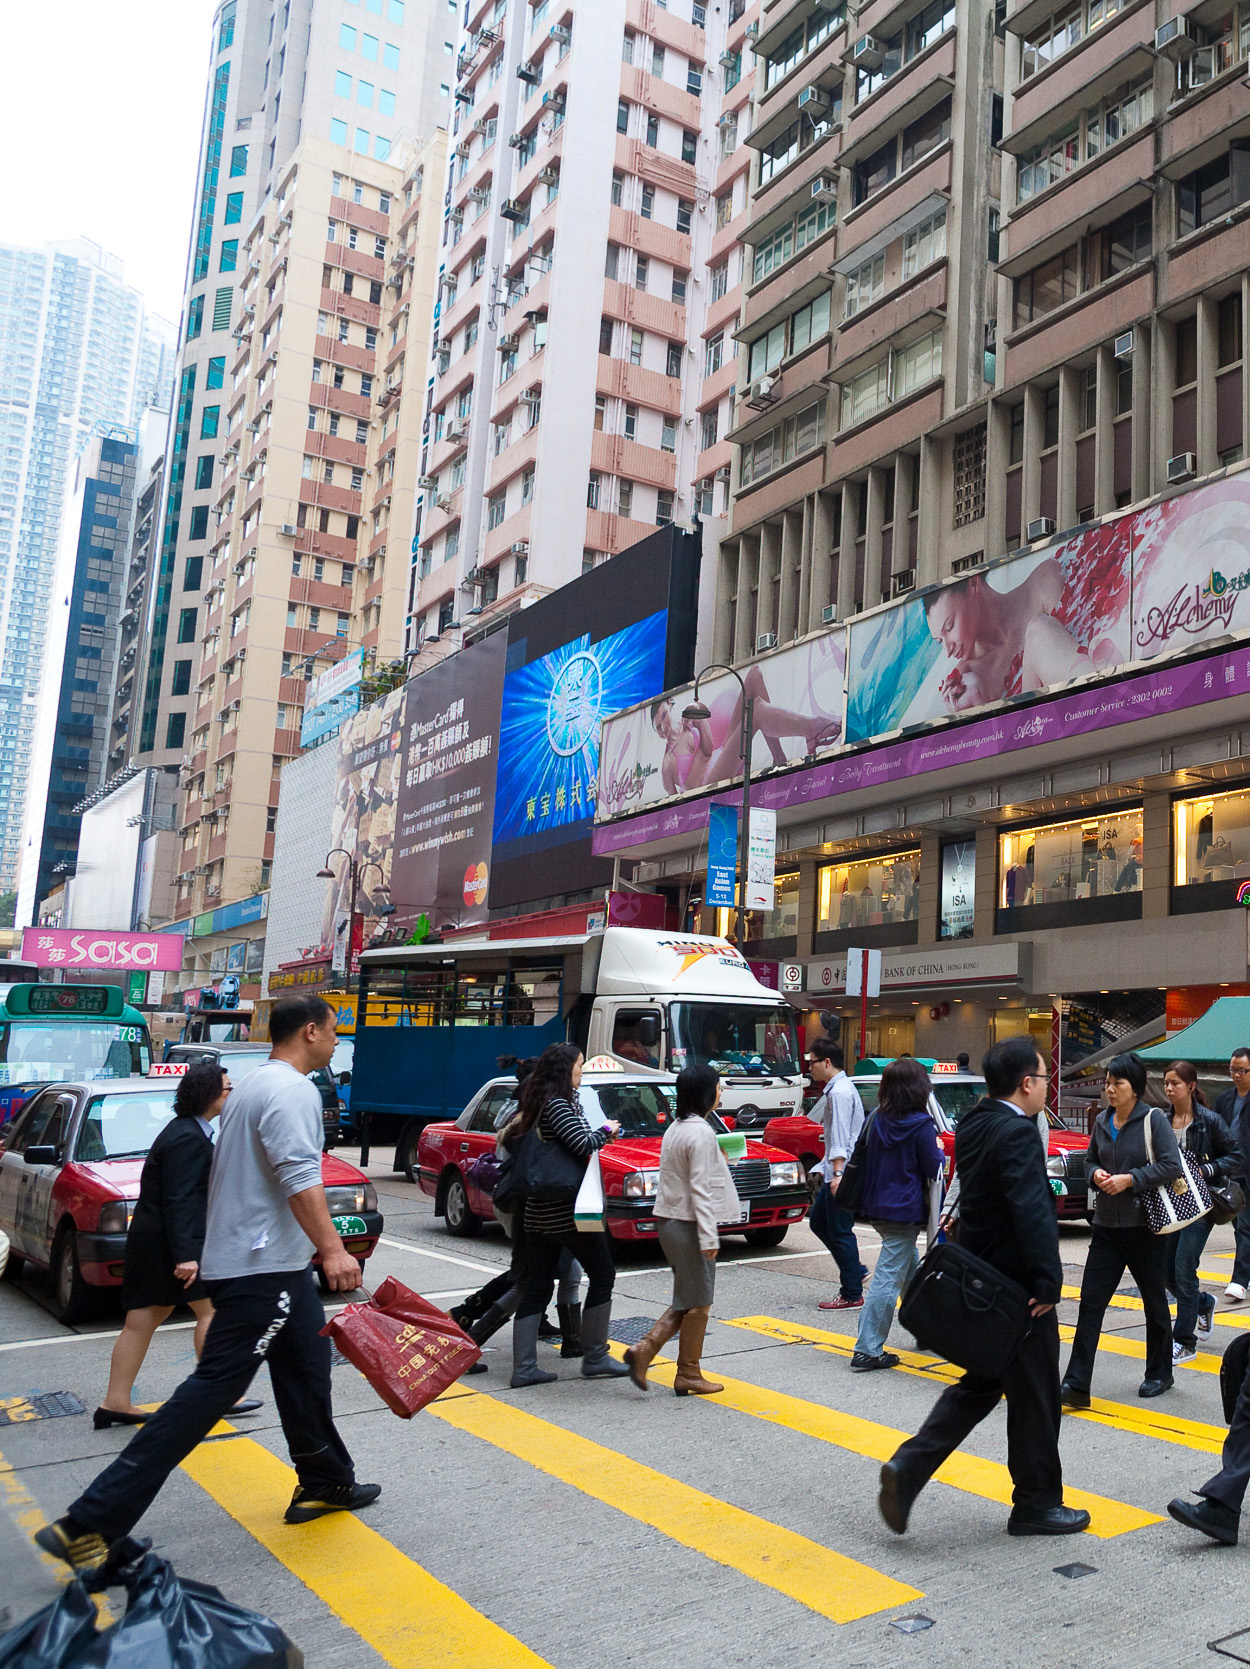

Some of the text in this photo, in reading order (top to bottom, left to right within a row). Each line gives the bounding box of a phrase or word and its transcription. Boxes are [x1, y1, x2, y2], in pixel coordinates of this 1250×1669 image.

[1064, 707, 1099, 722] Customer
[1100, 699, 1126, 713] Service
[1131, 691, 1150, 706] 2302
[1152, 686, 1173, 700] 0002
[801, 776, 827, 795] Facial
[838, 766, 862, 784] Body
[863, 758, 901, 776] Treatment
[1103, 828, 1118, 841] ISA
[464, 876, 488, 893] MasterCard
[712, 884, 731, 892] Games
[953, 895, 966, 906] ISA
[37, 936, 66, 963] 莎莎
[672, 945, 739, 959] 500
[884, 967, 905, 979] BANK
[906, 966, 916, 976] OF
[918, 963, 943, 976] CHINA
[61, 994, 75, 1004] 78
[120, 1026, 137, 1042] 78
[154, 1065, 188, 1075] TAXI
[341, 1220, 349, 1229] 5
[253, 1317, 287, 1356] YONEX
[409, 1344, 464, 1391] CHINA DUTY FREE
